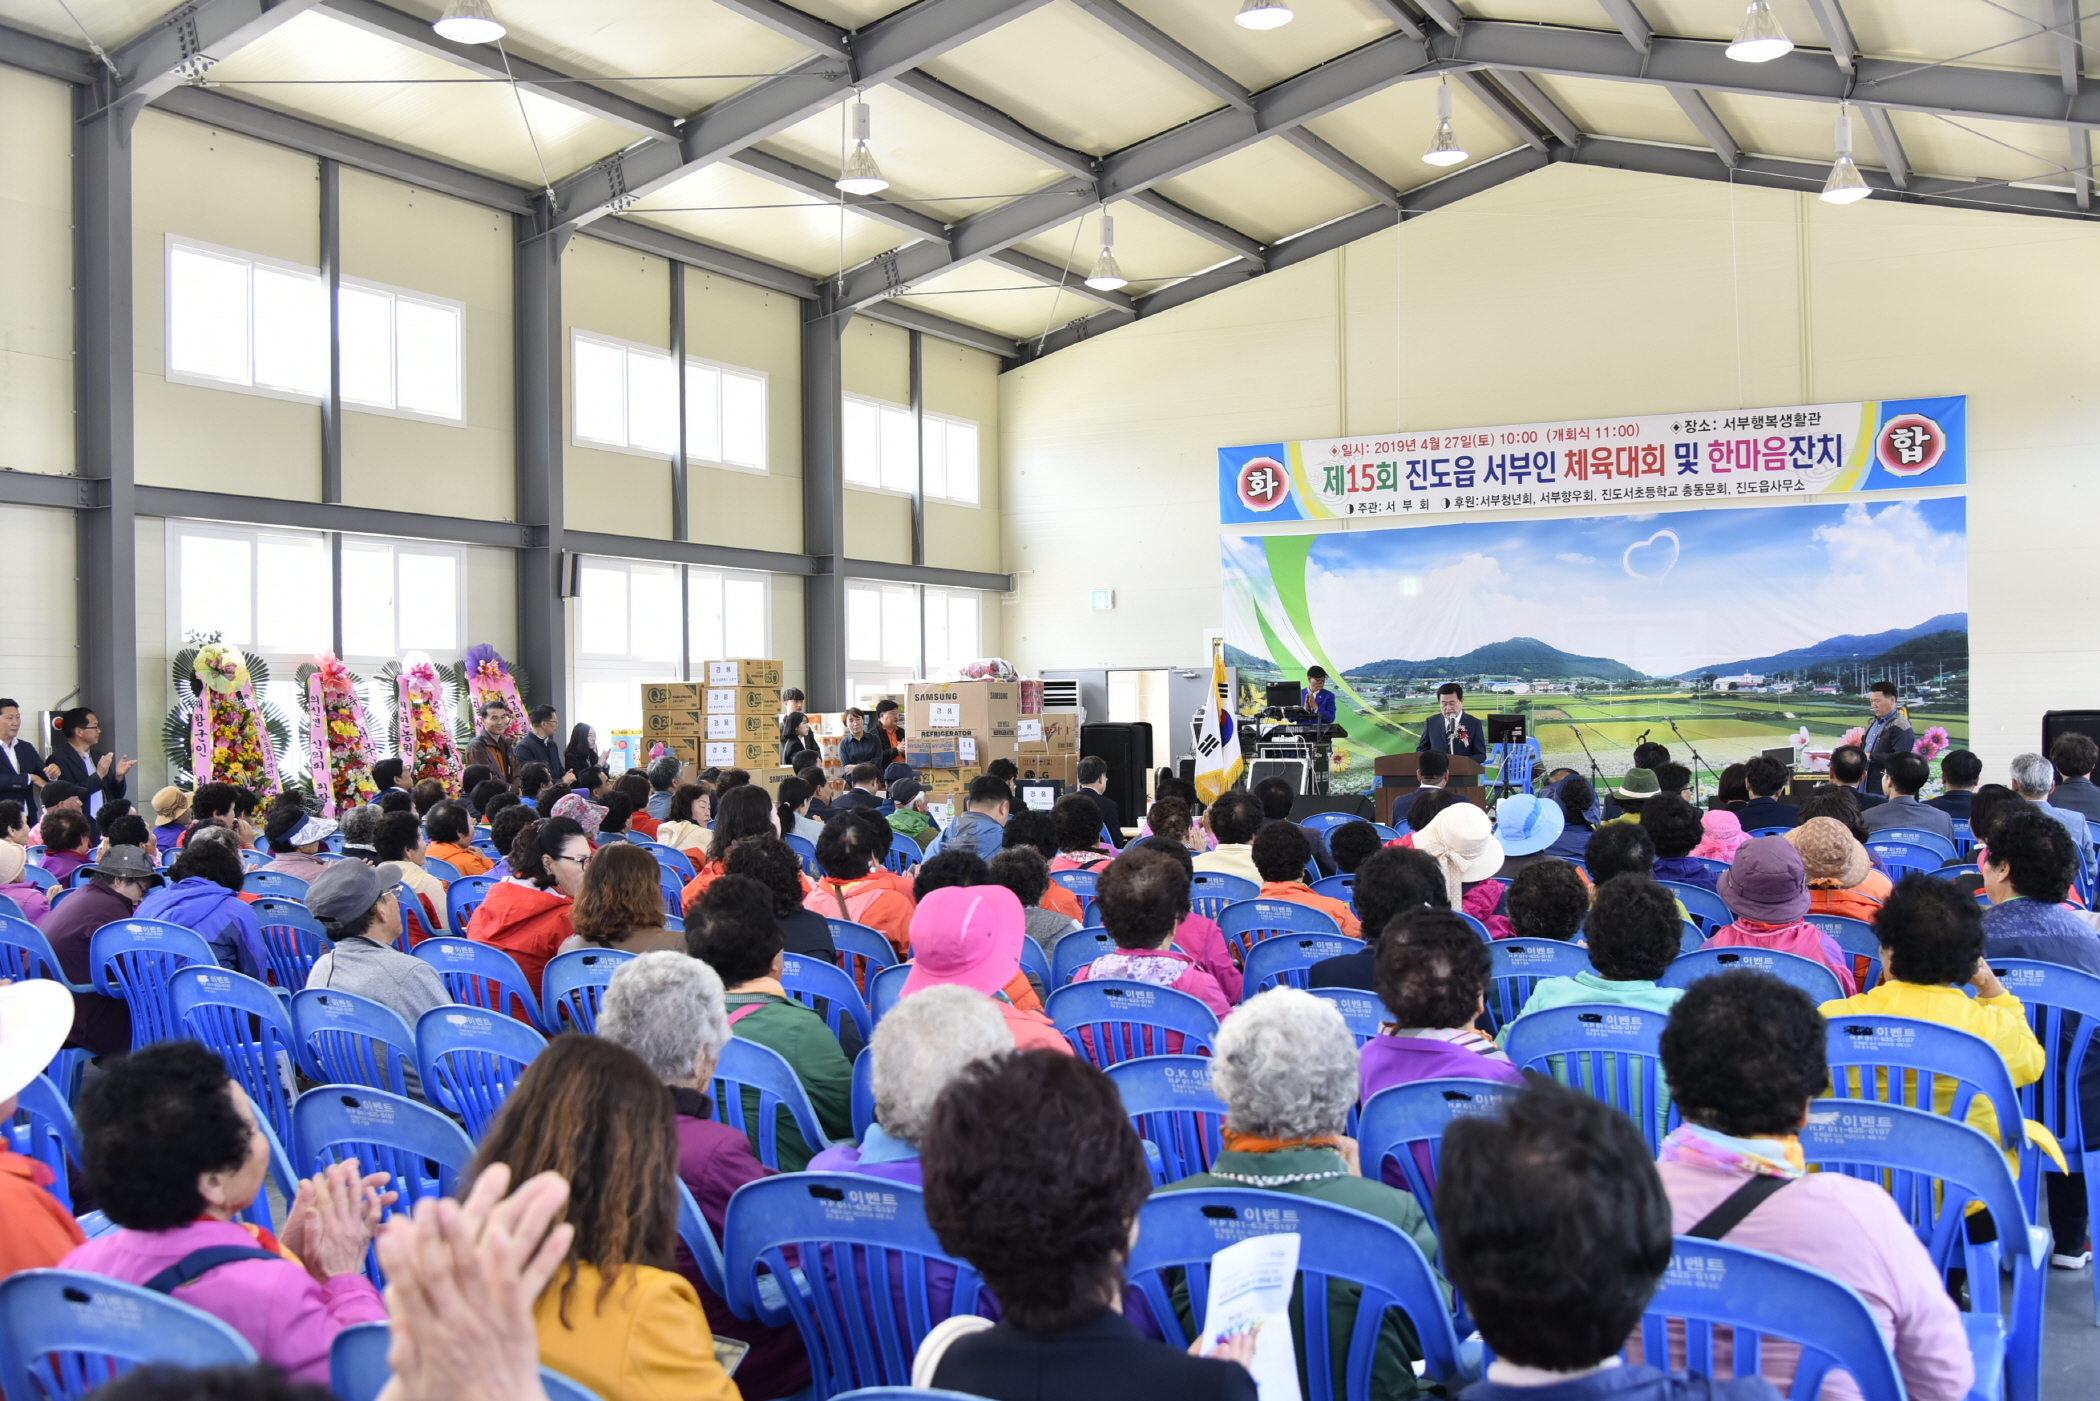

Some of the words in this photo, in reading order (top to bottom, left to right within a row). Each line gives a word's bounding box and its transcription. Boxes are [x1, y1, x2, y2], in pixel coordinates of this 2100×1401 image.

[1684, 420, 1718, 433] 장소:
[1723, 412, 1822, 431] 서부행복생활관
[1342, 444, 1370, 457] 일시:
[1374, 439, 1416, 454] 2019년
[1420, 437, 1440, 451] 4월
[1444, 432, 1495, 449] 27일(토)
[1500, 431, 1538, 445] 10:00
[1547, 426, 1591, 443] (개회식
[1596, 424, 1640, 440] 11:00)
[1889, 425, 1932, 465] 합
[1323, 461, 1399, 496] 제15회
[1406, 456, 1475, 491] 진도읍
[1483, 450, 1556, 486] 서부인
[1564, 442, 1665, 481] 체육대회
[1674, 442, 1699, 476] 및
[1708, 434, 1842, 474] 한마음잔치
[1246, 468, 1279, 501] 화
[1540, 489, 1597, 504] 서부향우회,
[1601, 486, 1678, 501] 진도서초등학교
[1682, 483, 1731, 497] 총동문회,
[1735, 479, 1805, 494] 진도읍사무소
[1357, 501, 1382, 514] 주관:
[648, 688, 671, 703] Q20
[915, 693, 957, 701] SAMSUNG
[1527, 947, 1555, 955] 이벤트
[1744, 956, 1774, 964] 이벤트
[2012, 969, 2046, 978] 이벤트
[1125, 990, 1155, 999] 이벤트
[1341, 1000, 1373, 1009] 이벤트
[1606, 1015, 1642, 1025] 이벤트
[1877, 1027, 1916, 1037] 이벤트
[362, 1100, 395, 1112] 이벤트
[1842, 1115, 1893, 1128] 이벤트
[849, 1190, 898, 1206] 이벤트
[1244, 1207, 1300, 1223] 이벤트
